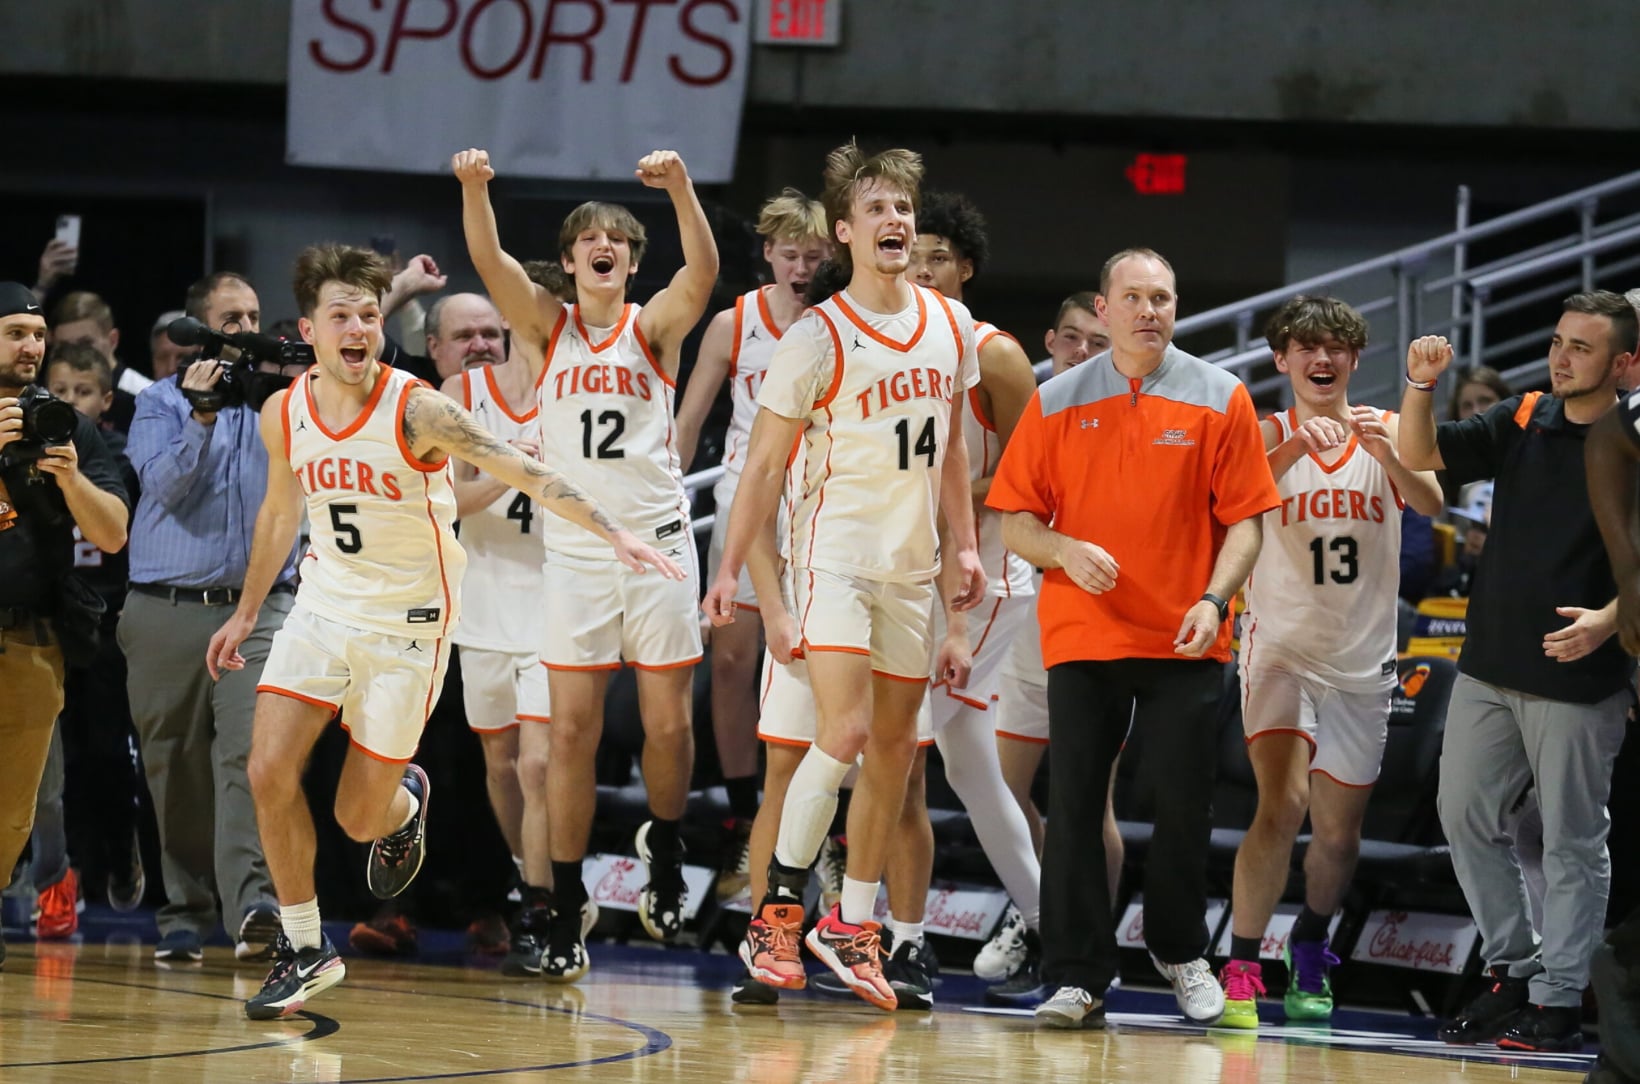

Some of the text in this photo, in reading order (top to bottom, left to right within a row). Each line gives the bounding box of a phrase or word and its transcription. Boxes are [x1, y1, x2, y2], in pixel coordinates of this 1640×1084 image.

[768, 0, 824, 38] EXIT
[308, 0, 741, 87] SPORTS
[555, 364, 652, 402] TIGERS
[580, 409, 626, 459] 12
[895, 416, 936, 470] 14
[296, 458, 402, 500] TIGERS
[328, 503, 362, 554] 5
[507, 491, 533, 533] 4
[1281, 488, 1385, 528] TIGERS
[1310, 535, 1358, 585] 13
